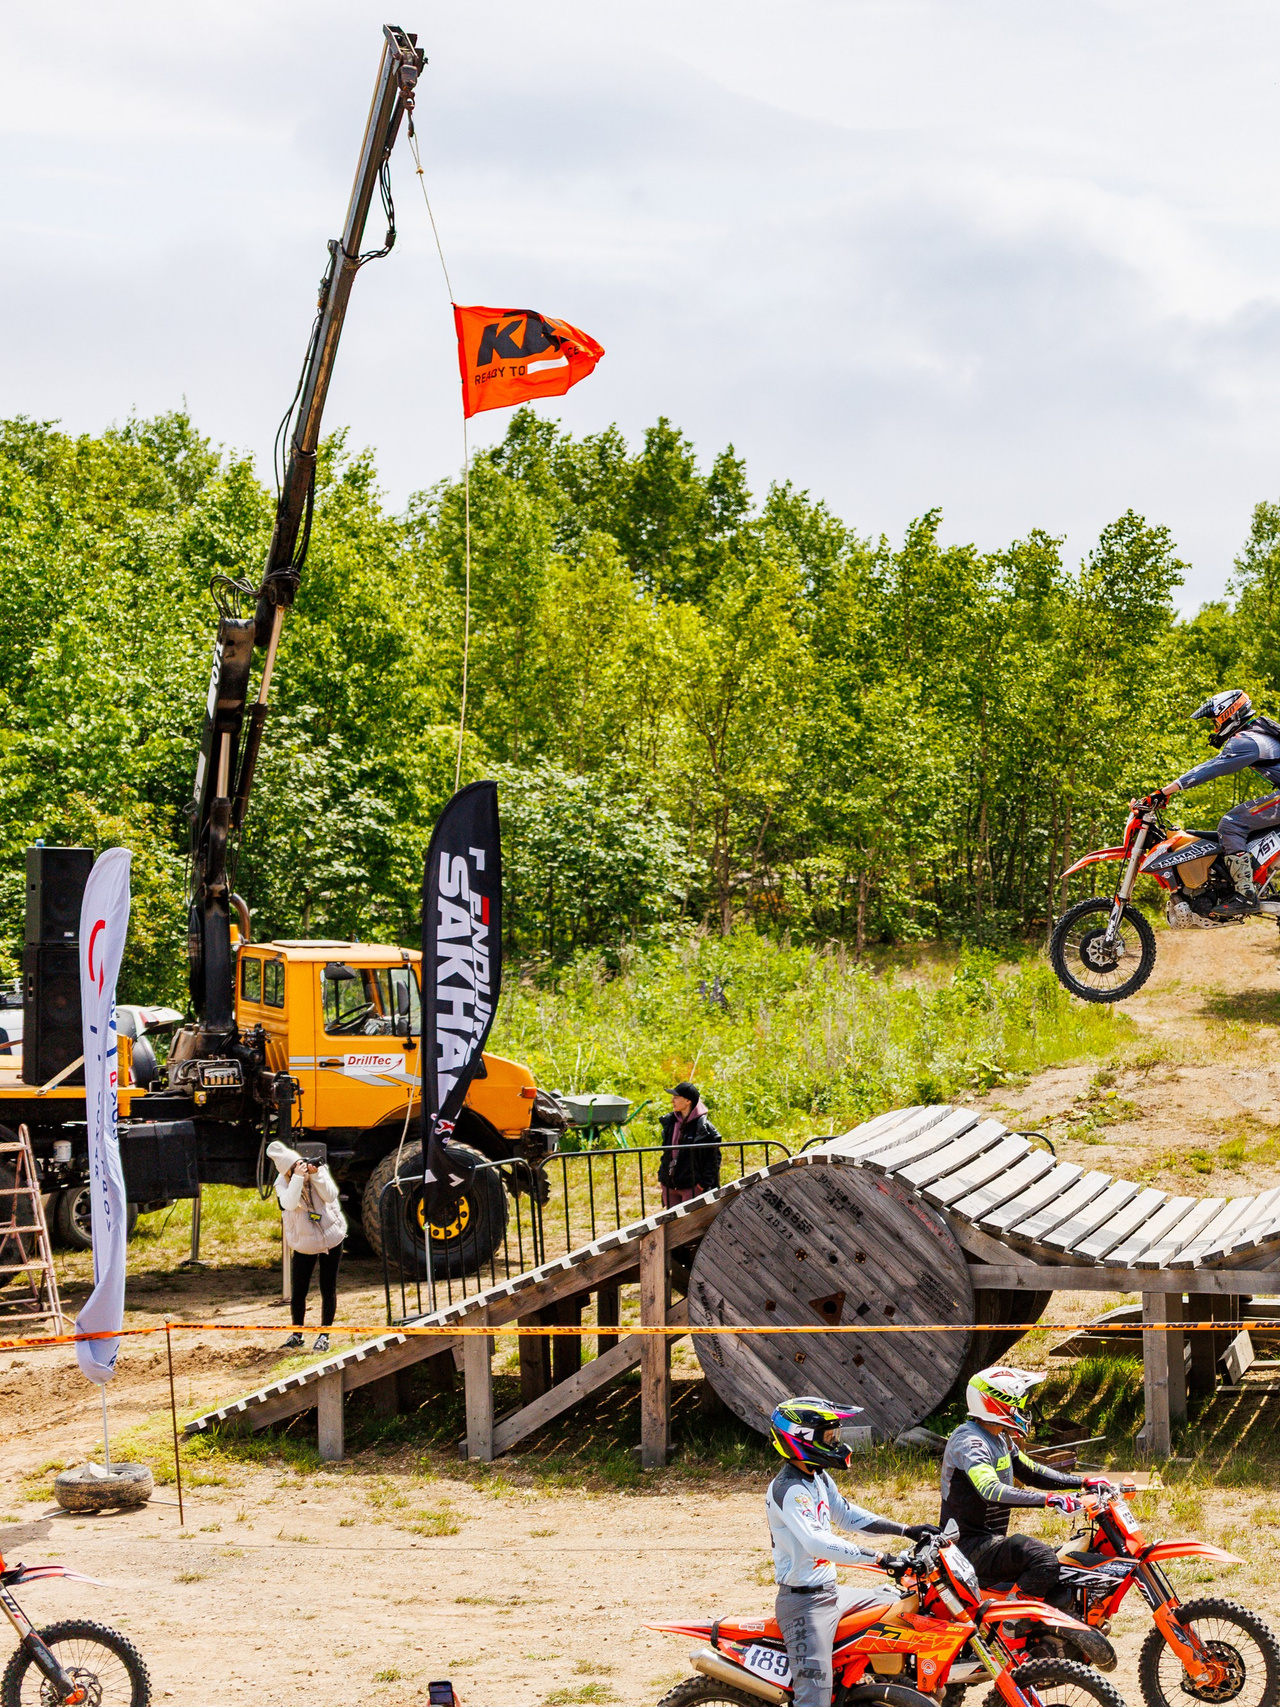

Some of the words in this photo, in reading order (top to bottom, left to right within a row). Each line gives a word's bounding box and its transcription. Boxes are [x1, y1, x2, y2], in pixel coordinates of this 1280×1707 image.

[475, 367, 506, 385] READY
[510, 366, 526, 376] TO
[1220, 702, 1242, 721] 100%
[347, 1056, 392, 1066] DrillTec
[986, 1386, 1021, 1406] 100%
[750, 1649, 790, 1677] 189
[798, 1669, 827, 1681] KTM
